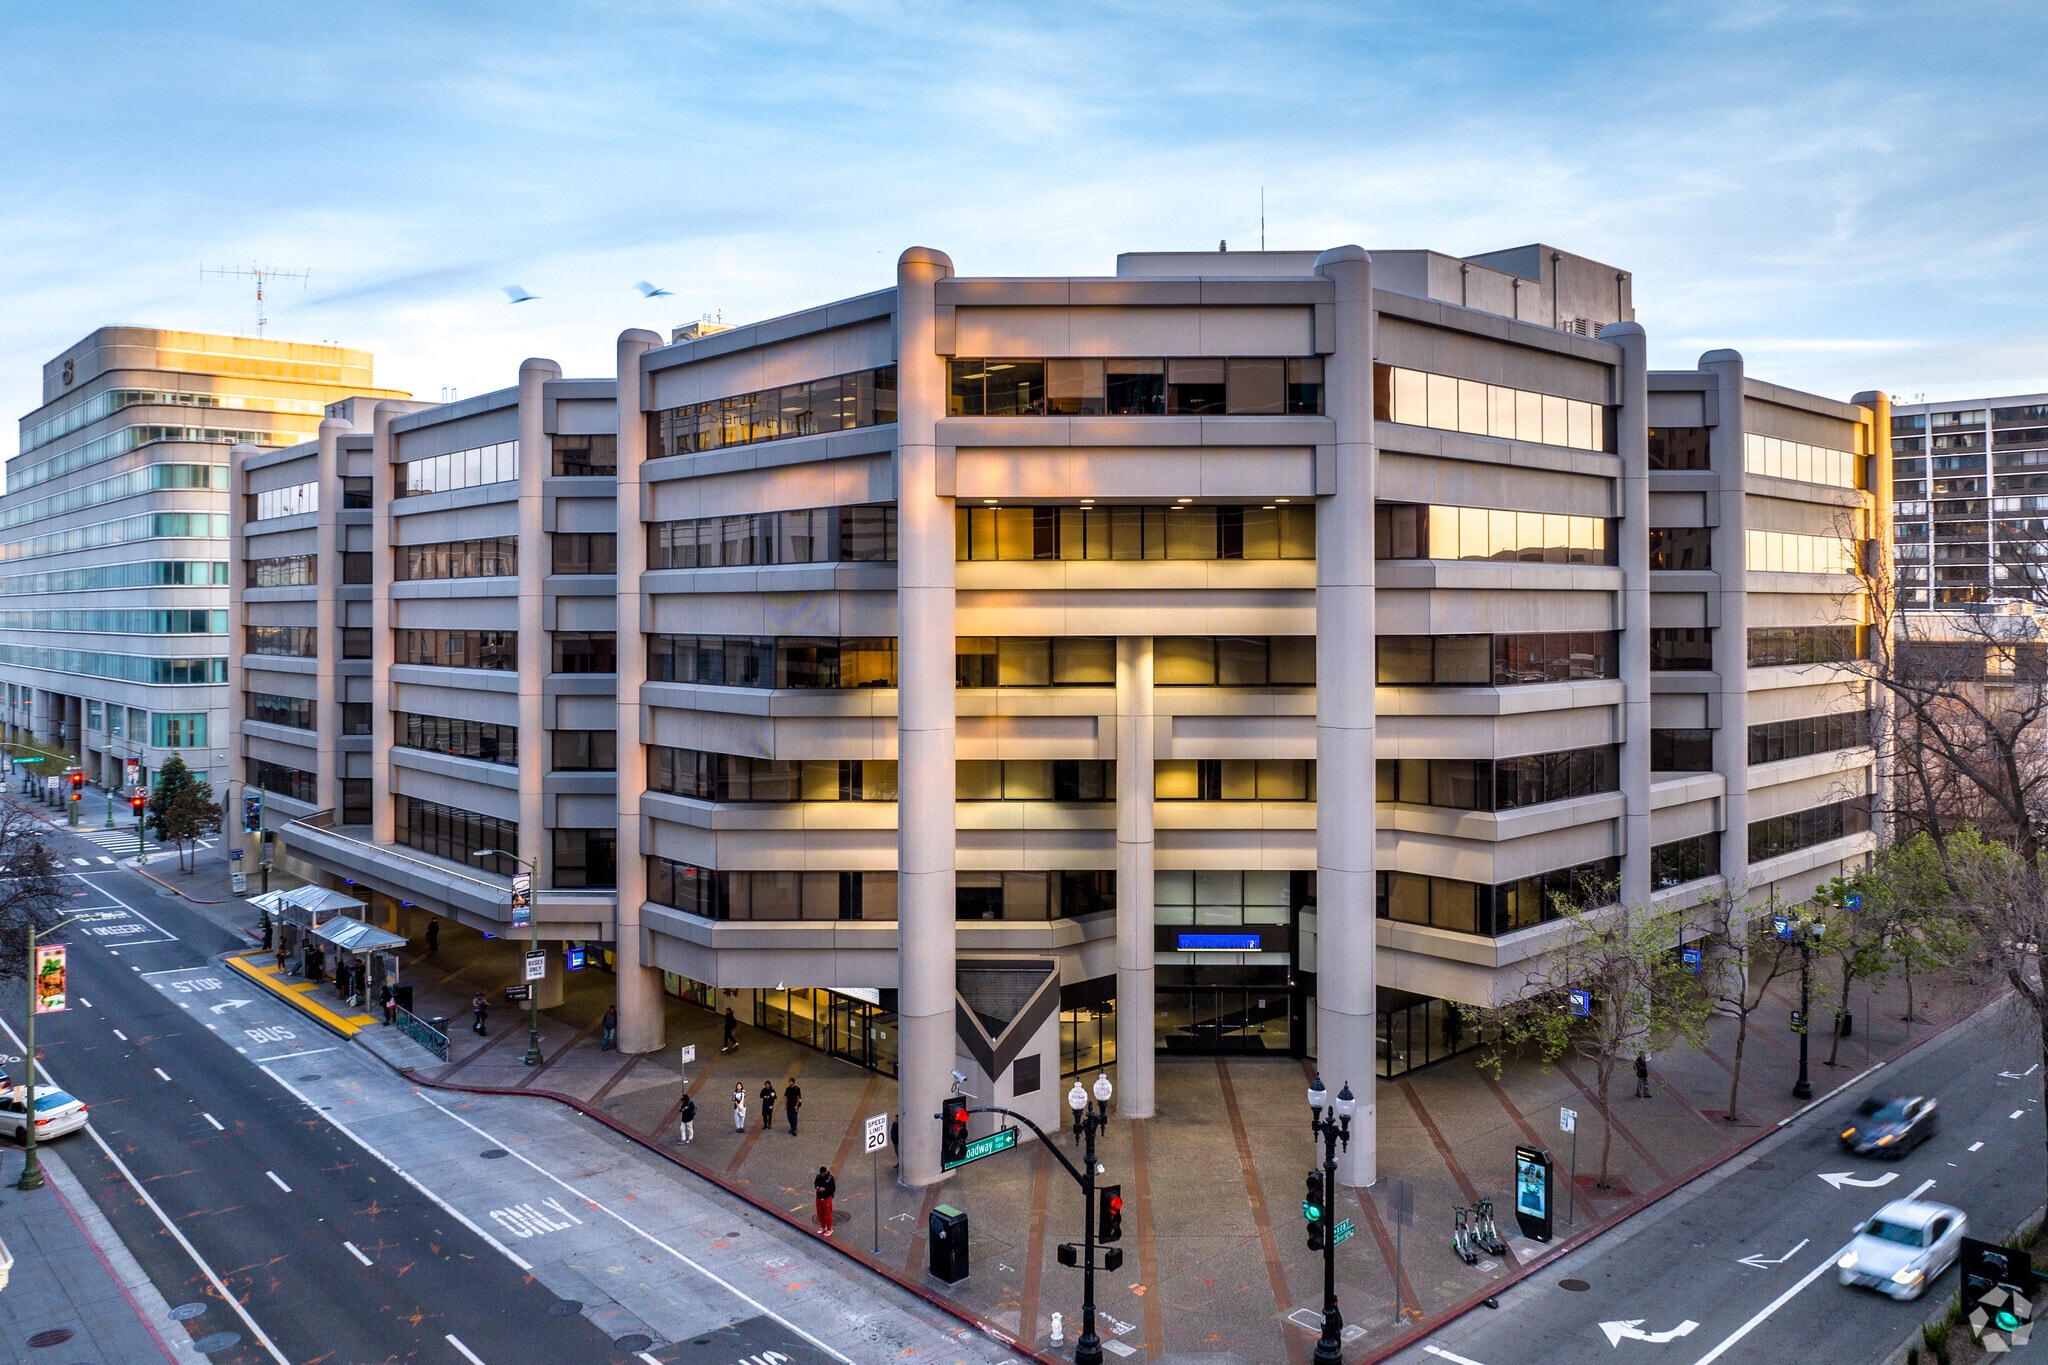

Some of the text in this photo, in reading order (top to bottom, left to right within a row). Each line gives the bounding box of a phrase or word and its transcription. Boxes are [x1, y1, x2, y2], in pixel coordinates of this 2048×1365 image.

[171, 977, 223, 993] STOP
[244, 1025, 296, 1044] BUS
[867, 1117, 886, 1128] SPEED
[869, 1125, 884, 1134] LIMIT
[868, 1132, 885, 1148] 20
[966, 1142, 993, 1159] oadway
[489, 1196, 583, 1239] ONLY
